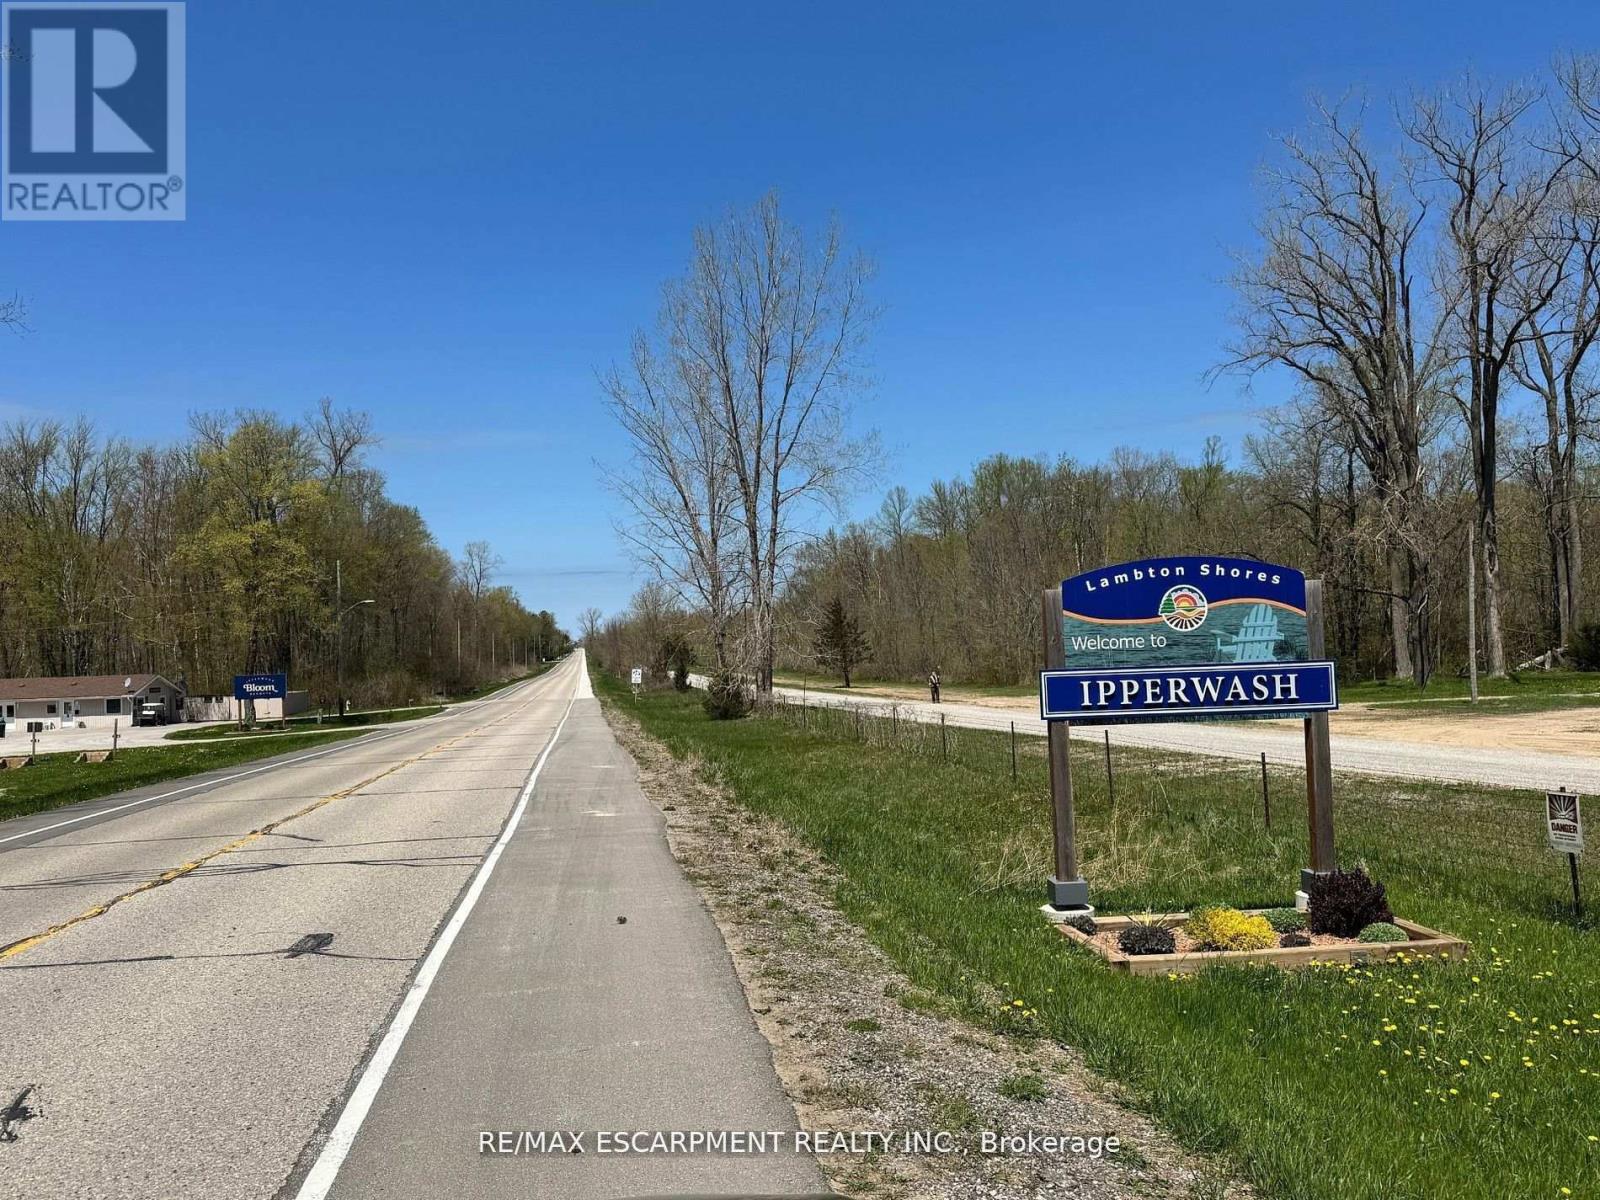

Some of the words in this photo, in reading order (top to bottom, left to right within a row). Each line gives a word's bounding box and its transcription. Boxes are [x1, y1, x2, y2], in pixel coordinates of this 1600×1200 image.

[1085, 565, 1185, 592] Lambton
[1200, 564, 1281, 585] Shores
[1071, 635, 1145, 651] Welcome
[1150, 634, 1167, 648] to
[243, 684, 278, 692] Bloom
[1079, 673, 1300, 707] IPPERWASH
